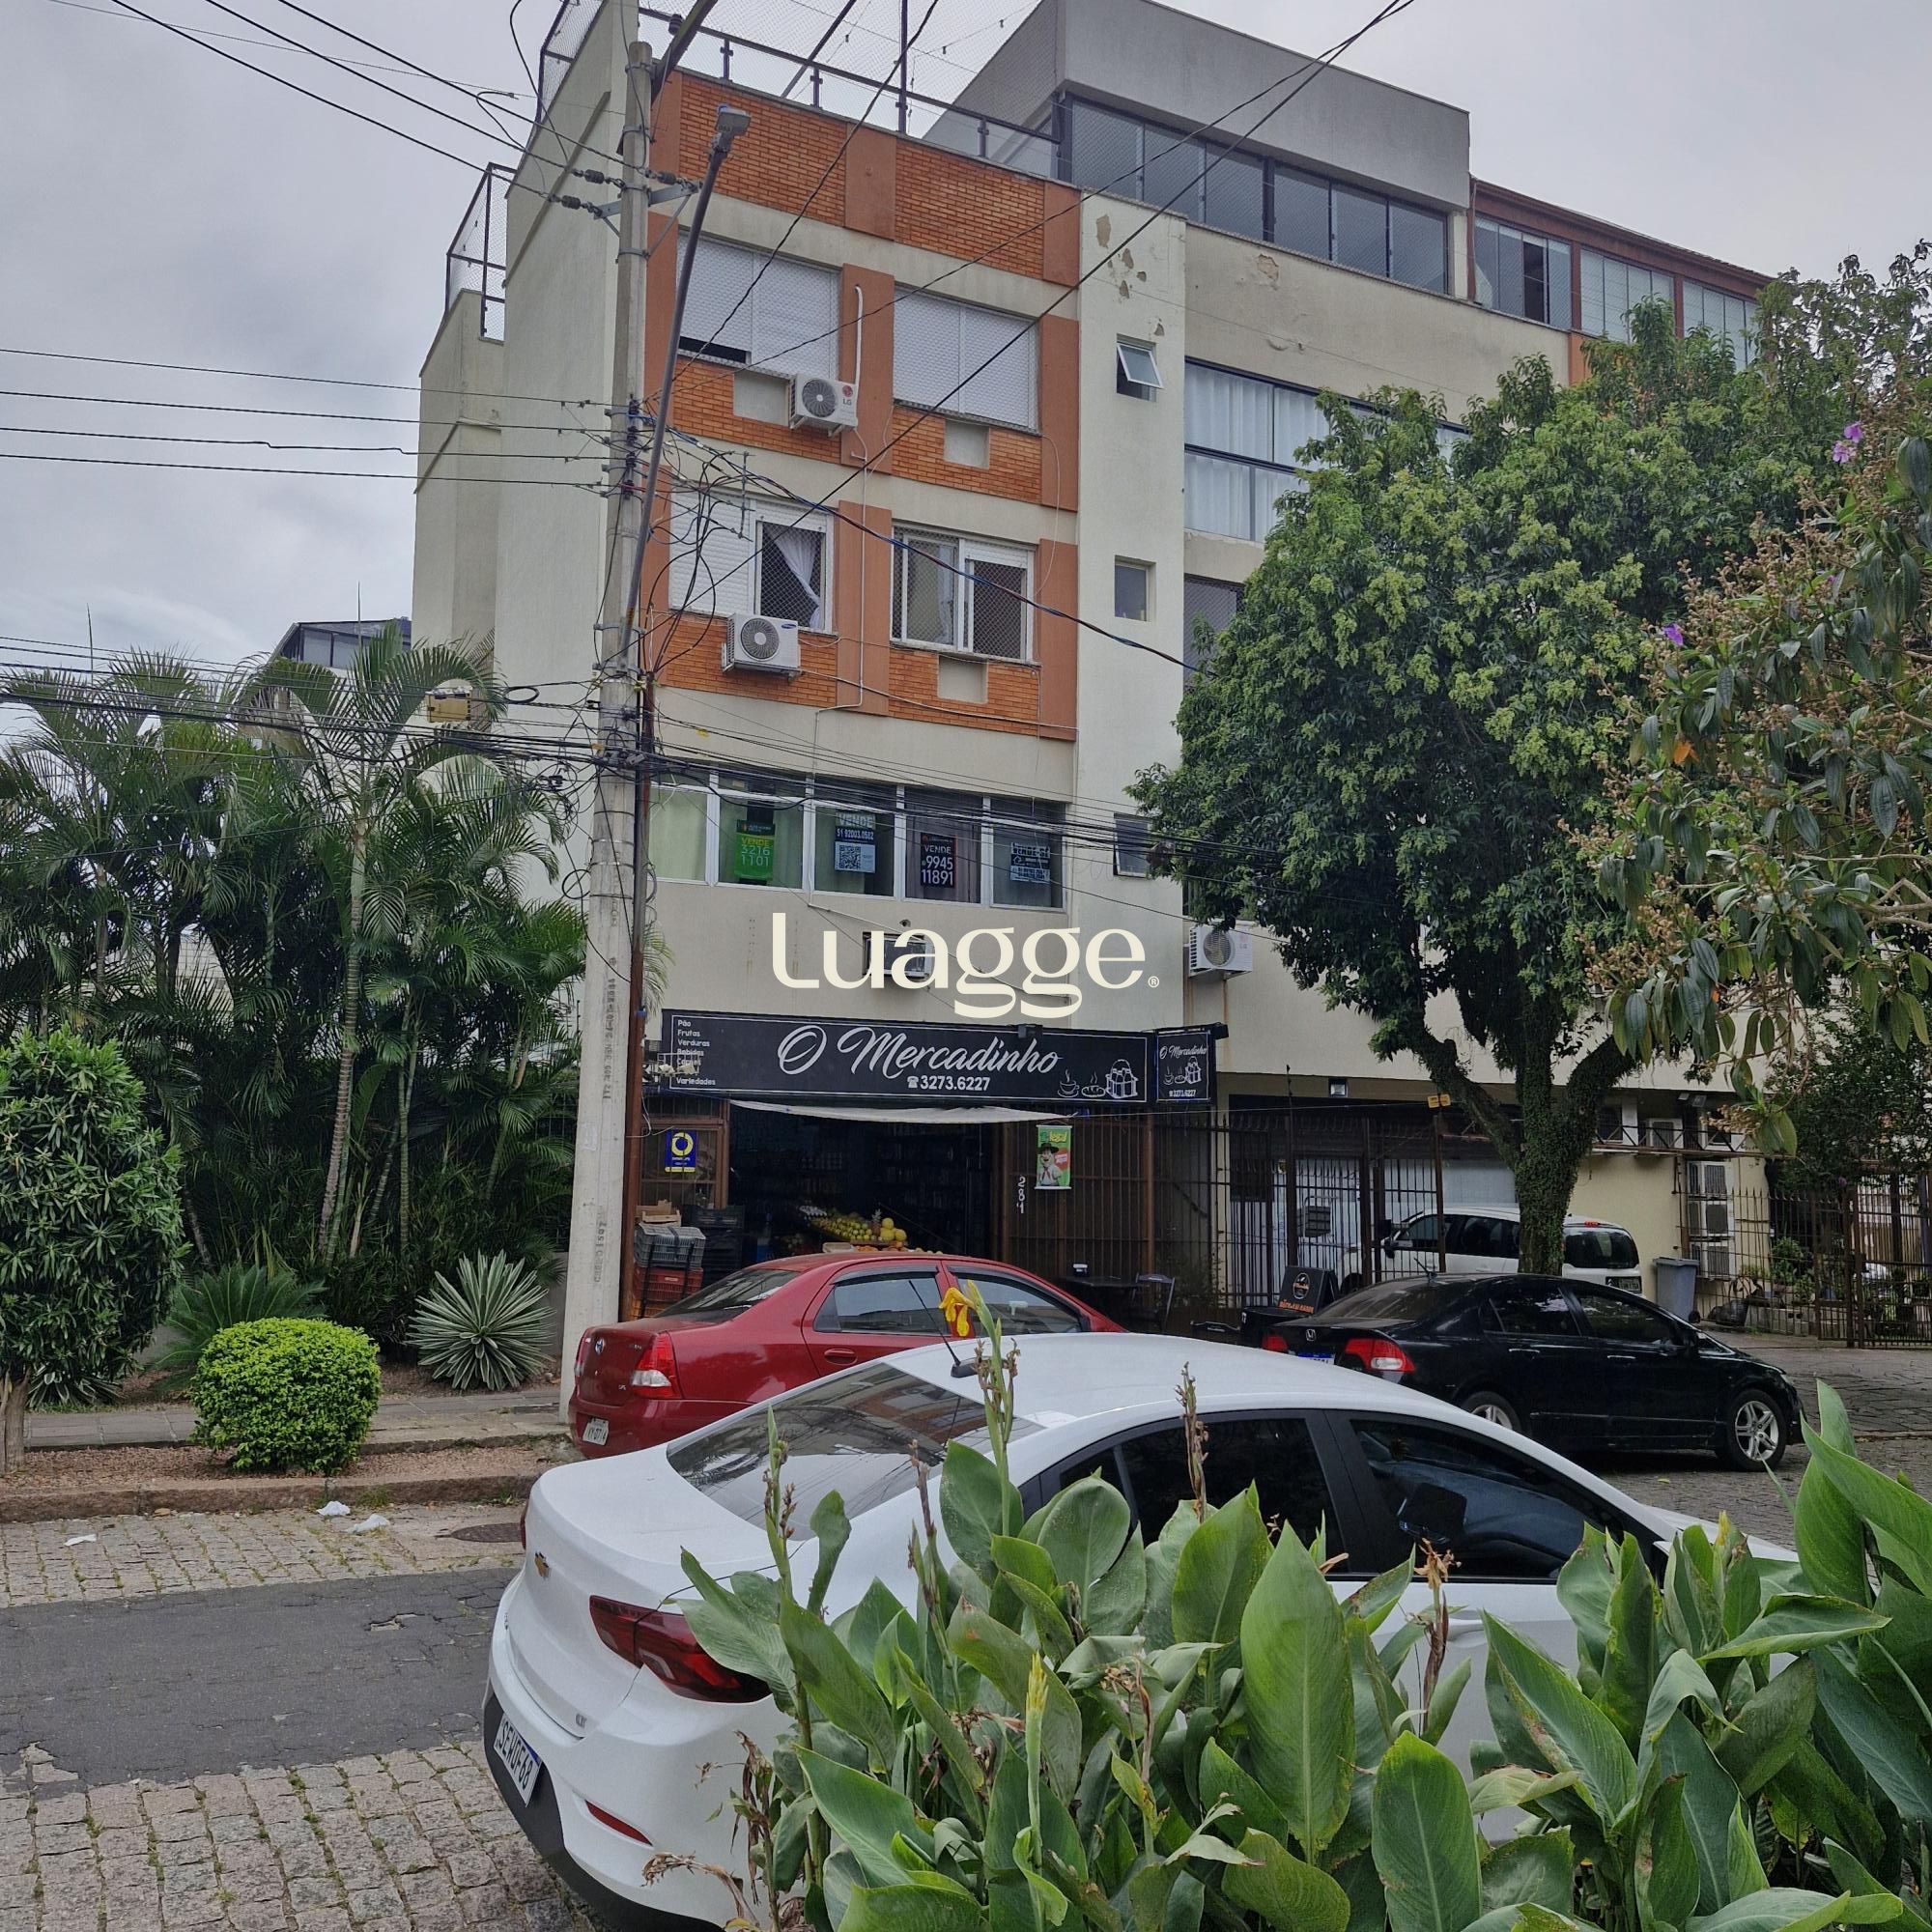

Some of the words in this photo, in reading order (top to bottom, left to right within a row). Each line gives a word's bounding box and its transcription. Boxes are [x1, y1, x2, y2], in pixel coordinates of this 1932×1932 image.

[742, 837, 770, 847] VENDE
[924, 844, 952, 855] VENDE
[742, 854, 770, 867] 1101
[926, 856, 953, 870] 9945
[922, 869, 953, 886] 11891
[677, 1029, 700, 1037] Frutas
[677, 1038, 710, 1047] Verduras
[778, 1025, 827, 1075] O
[838, 1027, 1064, 1079] Mercadinho
[1168, 1044, 1208, 1059] Mercadinho
[676, 1077, 716, 1086] Variedades
[920, 1075, 991, 1092] 3273.6227
[1016, 1176, 1027, 1214] 281
